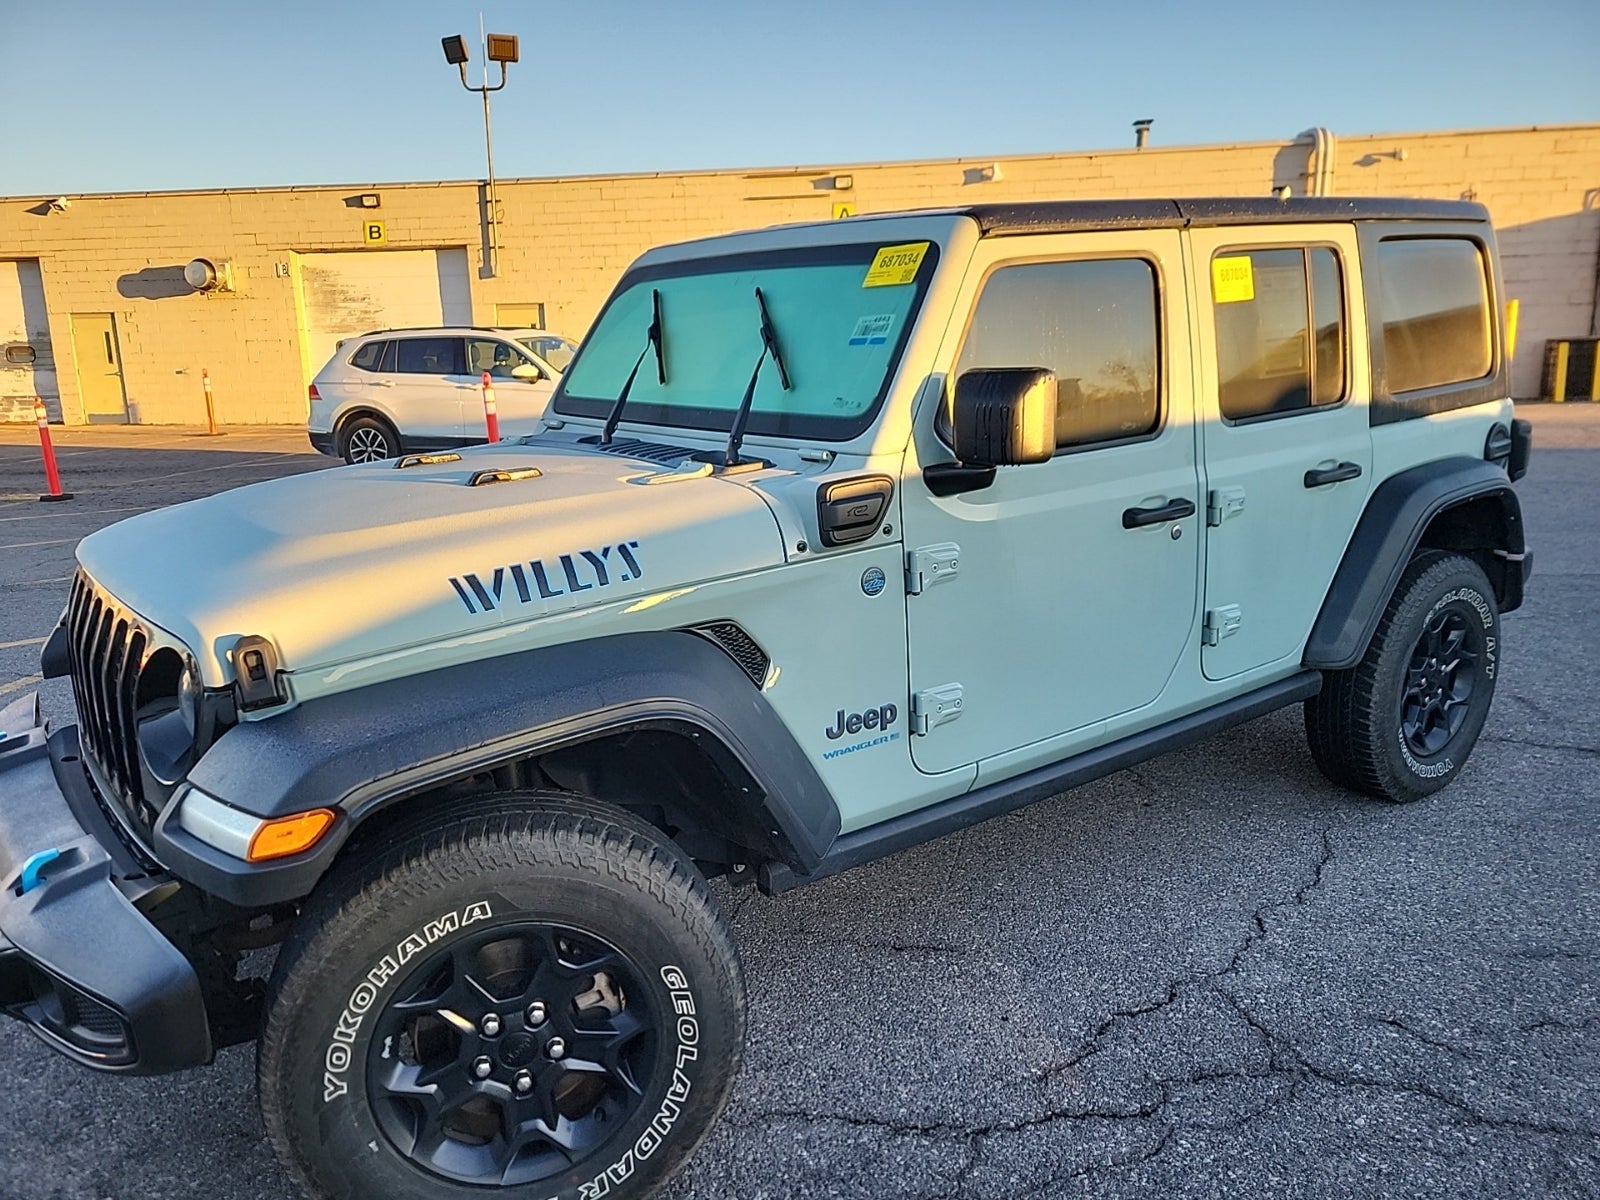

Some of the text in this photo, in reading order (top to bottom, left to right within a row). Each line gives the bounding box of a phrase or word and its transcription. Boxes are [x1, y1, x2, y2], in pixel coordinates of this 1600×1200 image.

[368, 225, 382, 240] B
[879, 252, 921, 269] 687034
[1220, 266, 1249, 282] 687034
[448, 541, 642, 615] WILLYS
[825, 703, 898, 741] Jeep
[822, 735, 889, 760] WRANGLER
[323, 900, 493, 1103] YOKOHAMA
[577, 965, 699, 1200] GEOLANDAR
